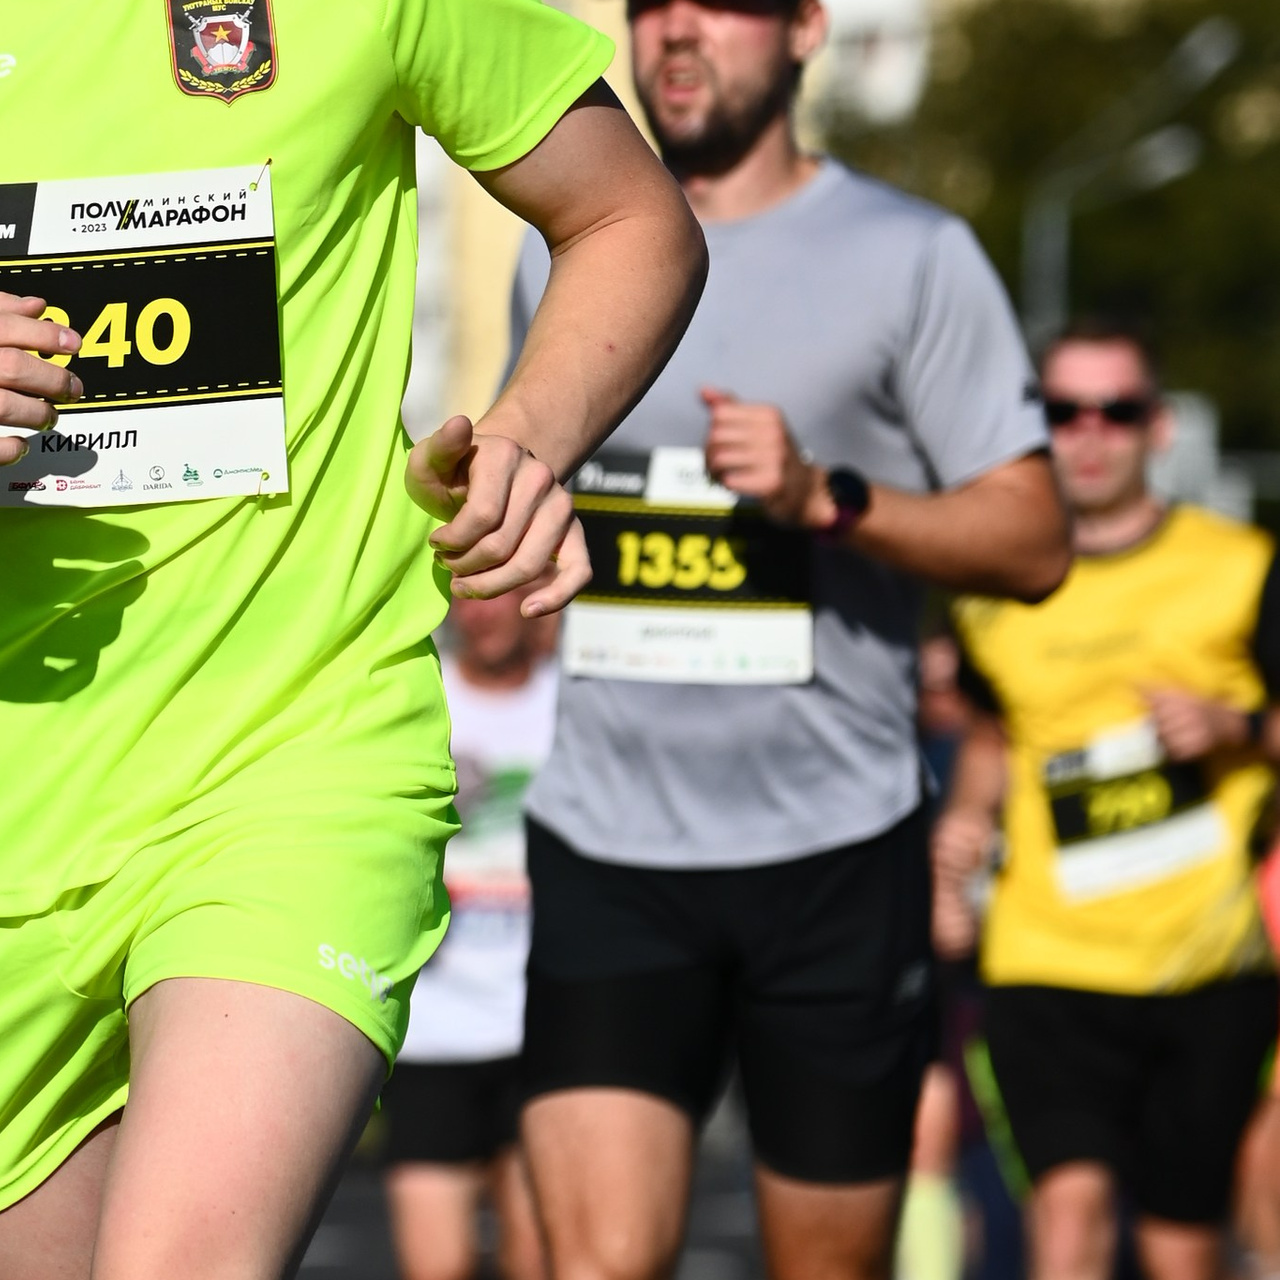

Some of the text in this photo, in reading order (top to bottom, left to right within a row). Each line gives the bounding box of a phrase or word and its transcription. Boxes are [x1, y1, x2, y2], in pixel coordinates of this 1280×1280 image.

[143, 188, 248, 208] МИНСКИЙ
[70, 200, 135, 226] ПОЛУ
[81, 223, 108, 233] 2023
[41, 430, 138, 453] КИРИЛЛ
[142, 482, 173, 491] DARIDA
